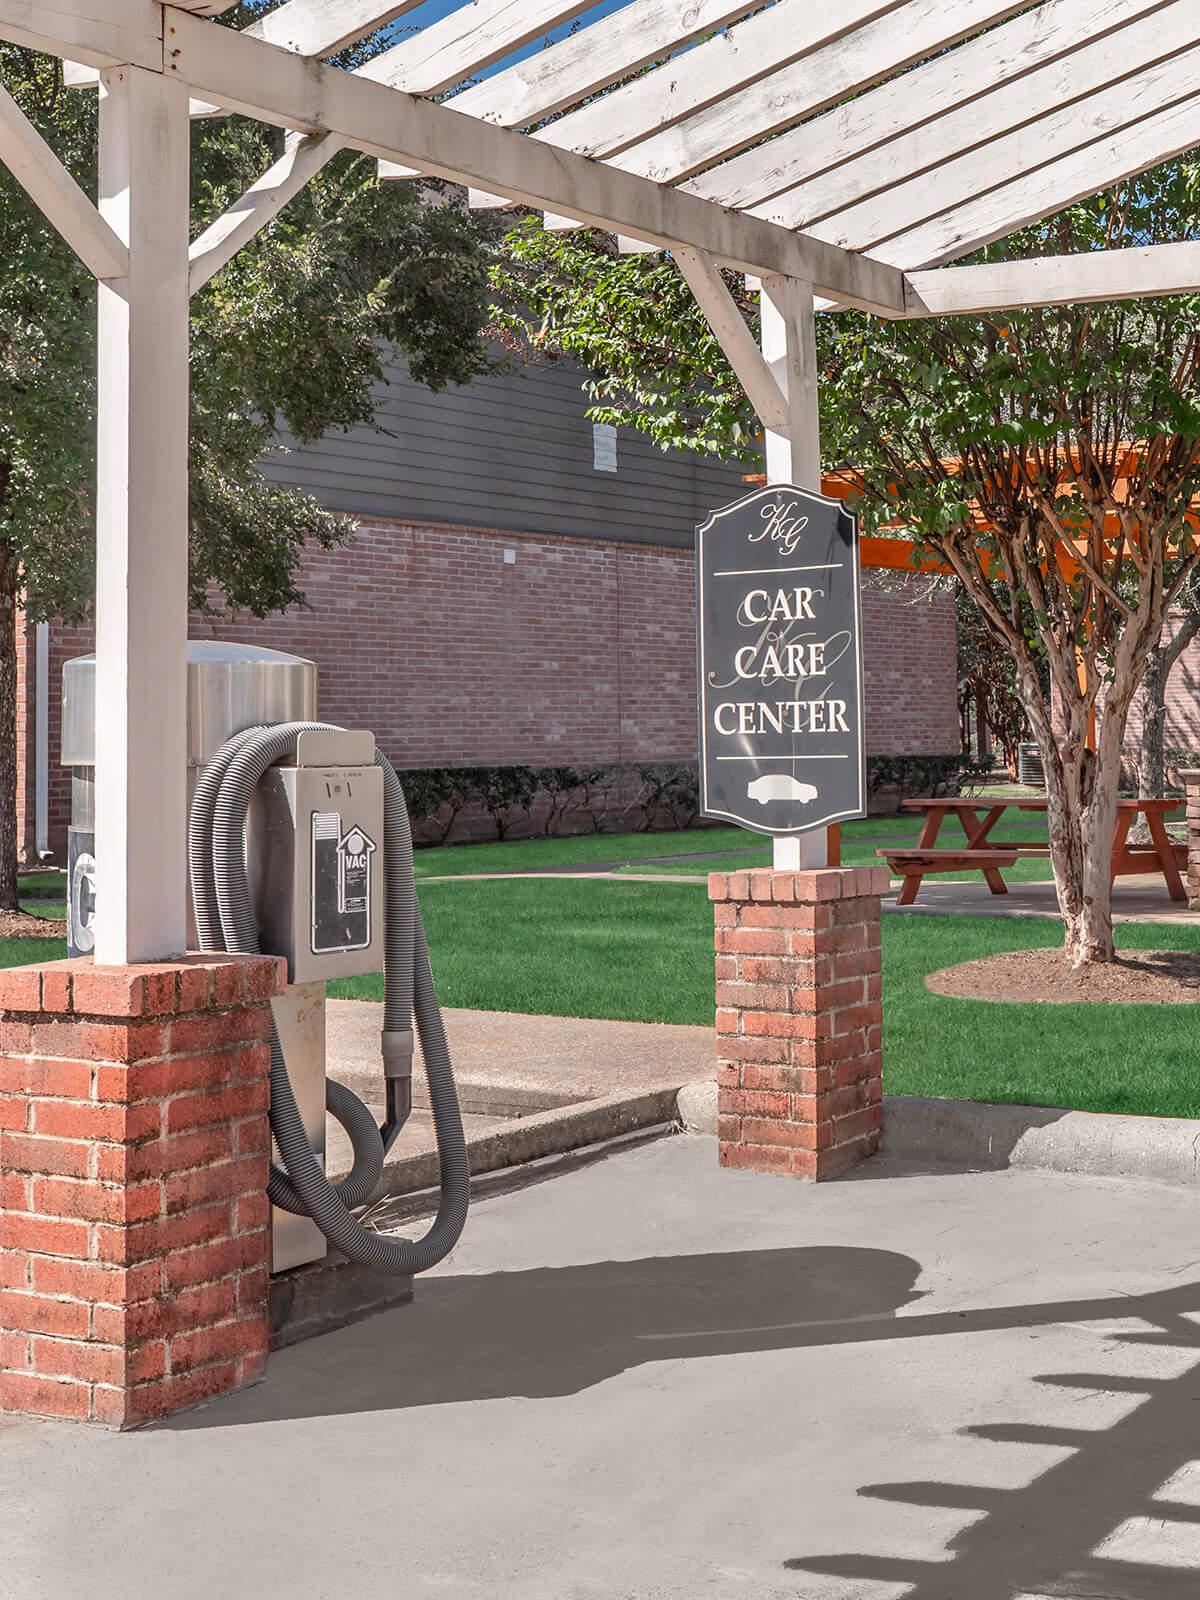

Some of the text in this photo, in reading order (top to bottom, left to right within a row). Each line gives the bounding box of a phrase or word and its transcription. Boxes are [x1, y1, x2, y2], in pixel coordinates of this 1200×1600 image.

[743, 586, 817, 623] CAR
[734, 643, 827, 679] CARE
[713, 699, 851, 736] CENTER
[345, 854, 367, 869] VAC
